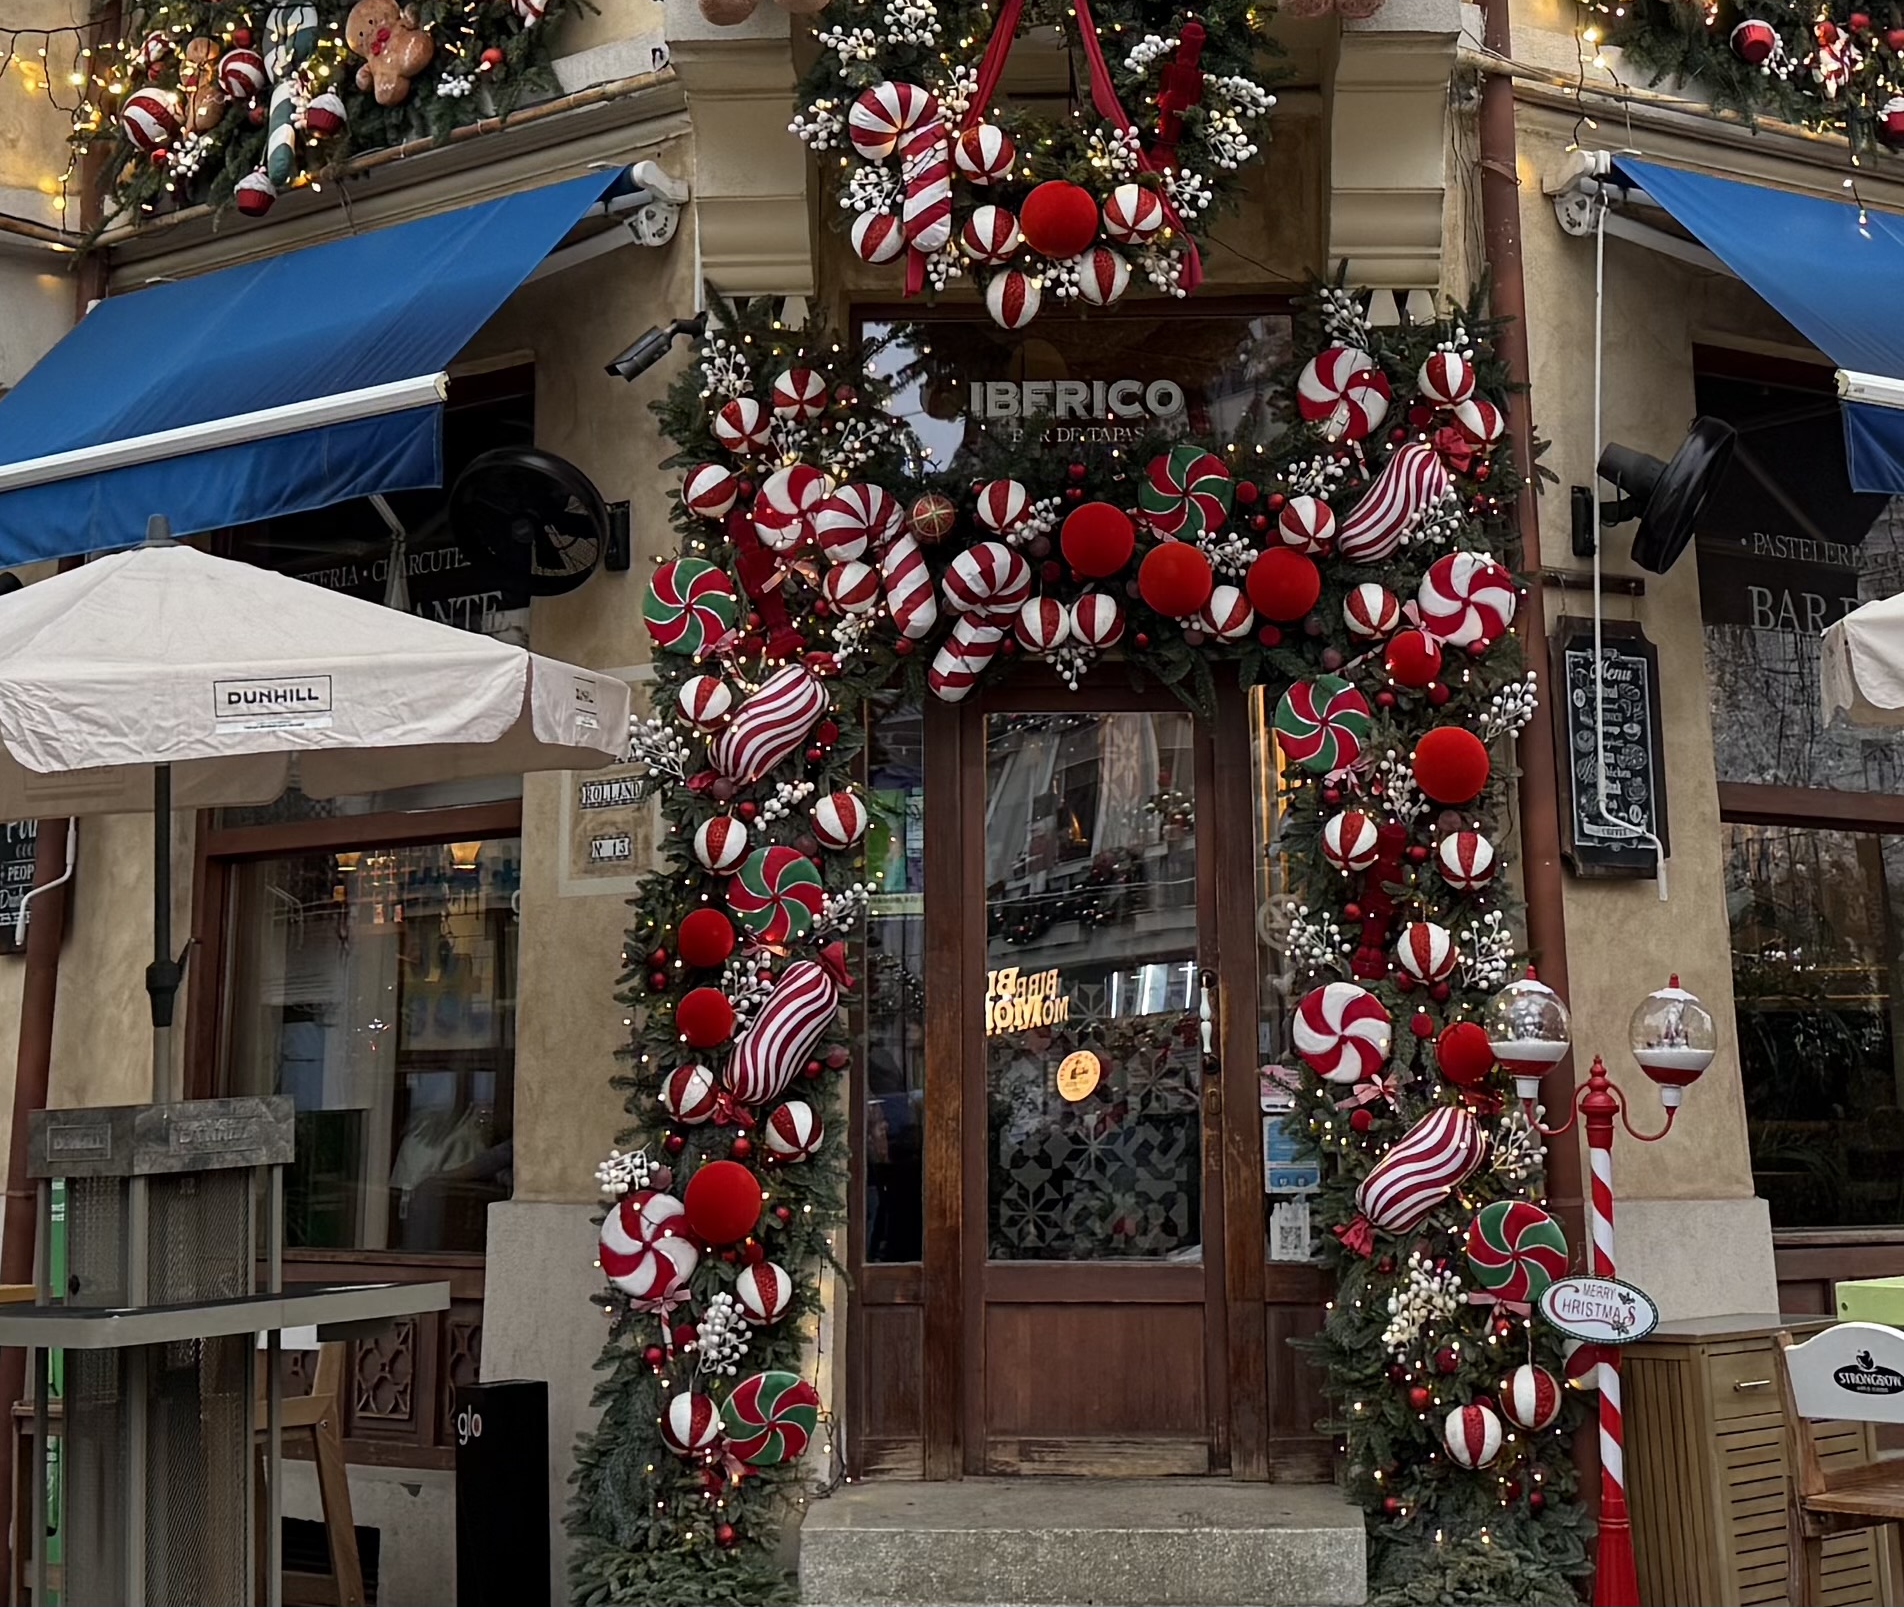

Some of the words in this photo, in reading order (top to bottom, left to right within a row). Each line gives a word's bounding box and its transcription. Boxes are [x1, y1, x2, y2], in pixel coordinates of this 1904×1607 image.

[968, 379, 1187, 420] IBERICO
[1012, 428, 1051, 443] BR
[1747, 585, 1827, 636] BAR
[226, 687, 320, 706] DUNHILL
[7, 864, 35, 883] PEOP
[1582, 1282, 1617, 1301] MERRY
[1549, 1283, 1636, 1327] CHRISTMAS
[1838, 1372, 1904, 1388] STRONGBOW
[457, 1404, 483, 1446] glo
